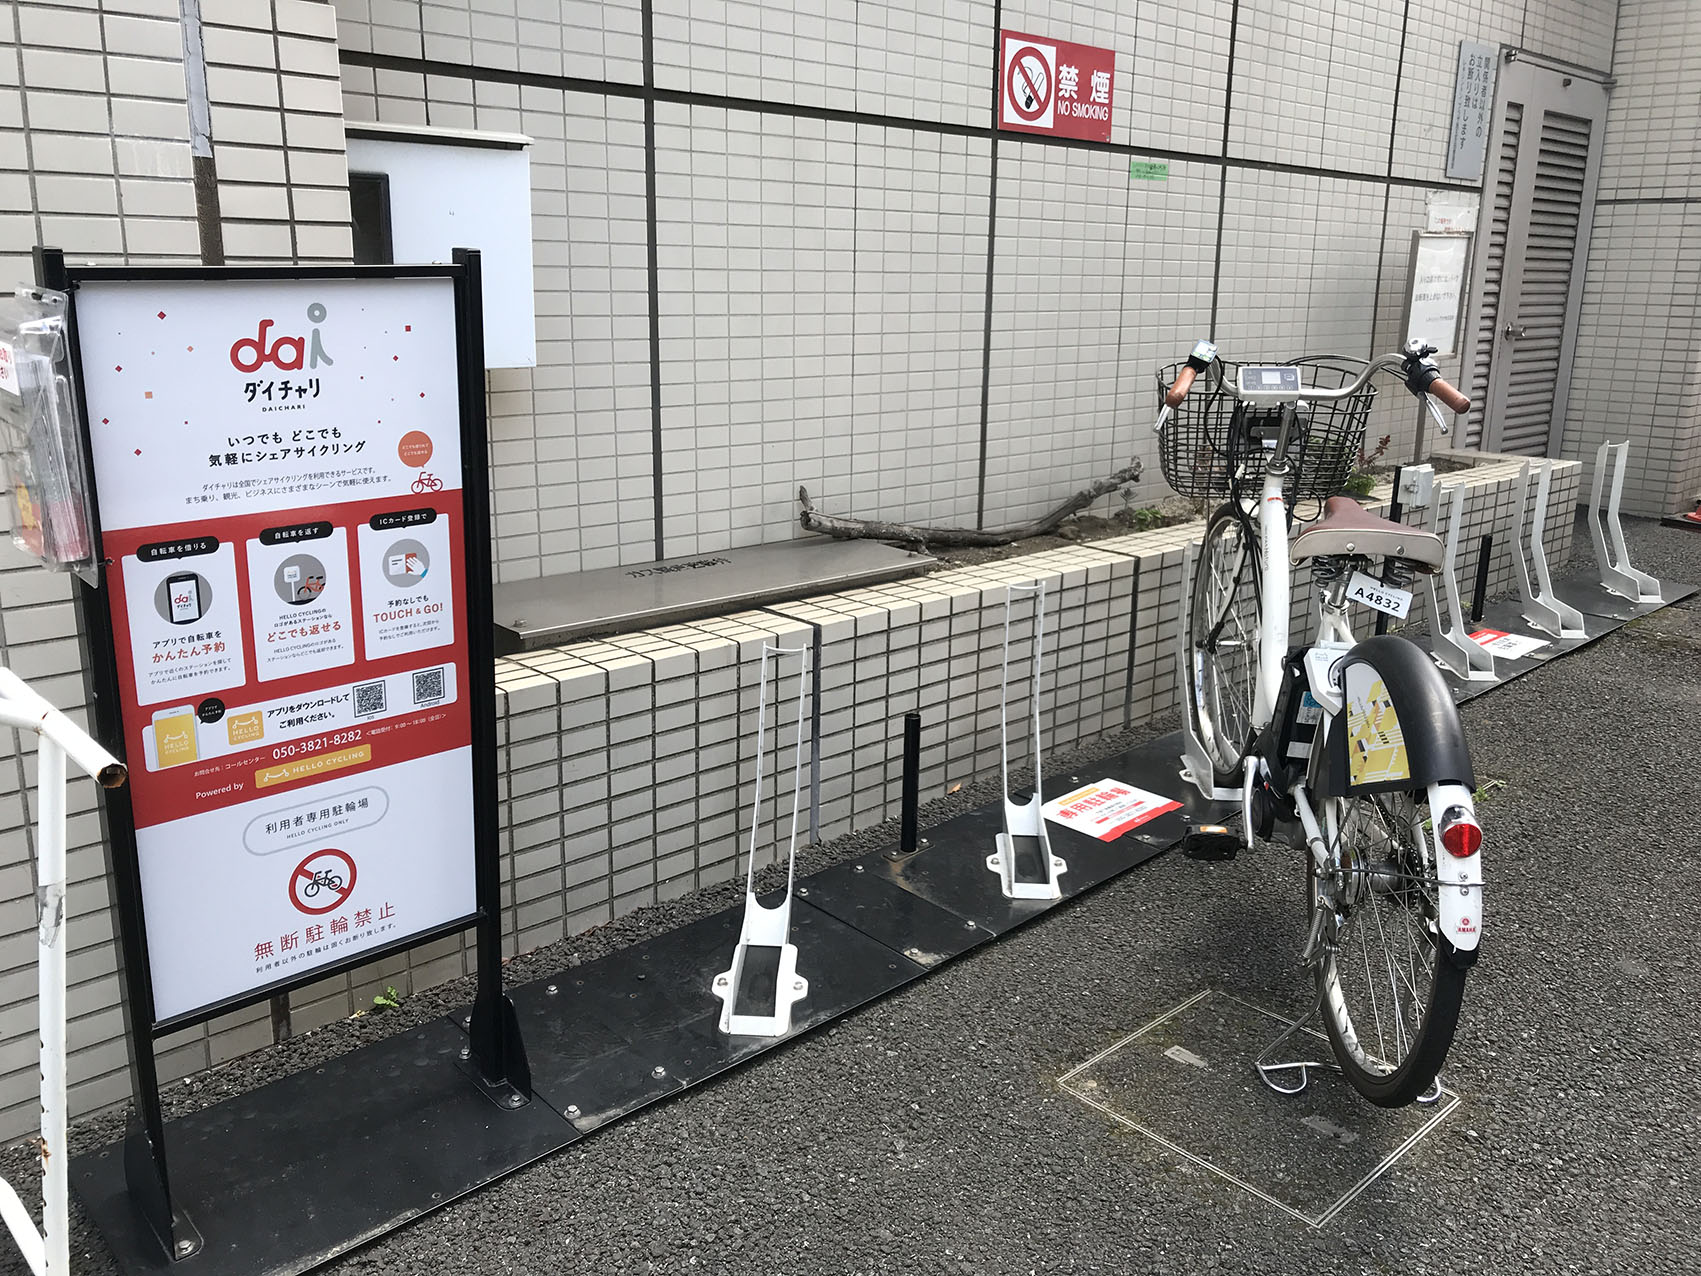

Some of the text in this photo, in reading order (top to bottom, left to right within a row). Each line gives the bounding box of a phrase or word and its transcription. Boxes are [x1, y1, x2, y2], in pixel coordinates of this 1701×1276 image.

[1058, 64, 1111, 104] 禁煙
[1057, 100, 1109, 121] NO SMOKING
[229, 302, 335, 374] dai
[244, 378, 321, 403] ダイチャリ
[261, 404, 306, 413] DAICHARI
[228, 426, 342, 447] いつでも どこでも
[208, 440, 366, 468] 気軽にシェアサイクリング
[379, 512, 428, 526] ICカード登録で
[274, 526, 320, 540] 自転車を返す
[150, 542, 208, 557] 自転車を借りる
[387, 594, 429, 608] 予約なしでも
[1354, 587, 1401, 612] A4832
[279, 612, 298, 621] HELLO
[373, 608, 413, 624] TOUCH
[423, 602, 443, 615] GO!
[152, 630, 223, 650] アプリで自転車を
[267, 620, 342, 643] どこでも返せる
[152, 641, 226, 664] かんたん予約
[267, 693, 350, 718] アプリをダウンロードして
[232, 726, 260, 736] HELLO
[279, 711, 335, 729] ご利用ください。
[164, 740, 189, 750] HELLO
[272, 729, 362, 760] 050-3821-8282
[195, 751, 365, 800] Powered by HELLO CYCLING
[265, 797, 369, 835] 利用者専用駐輪場
[286, 818, 350, 839] HELLO CYCLING ONLY
[254, 901, 396, 962] 無断駐輪禁止
[255, 923, 397, 973] 利用者以外の駐輪は固くお断り致します。
